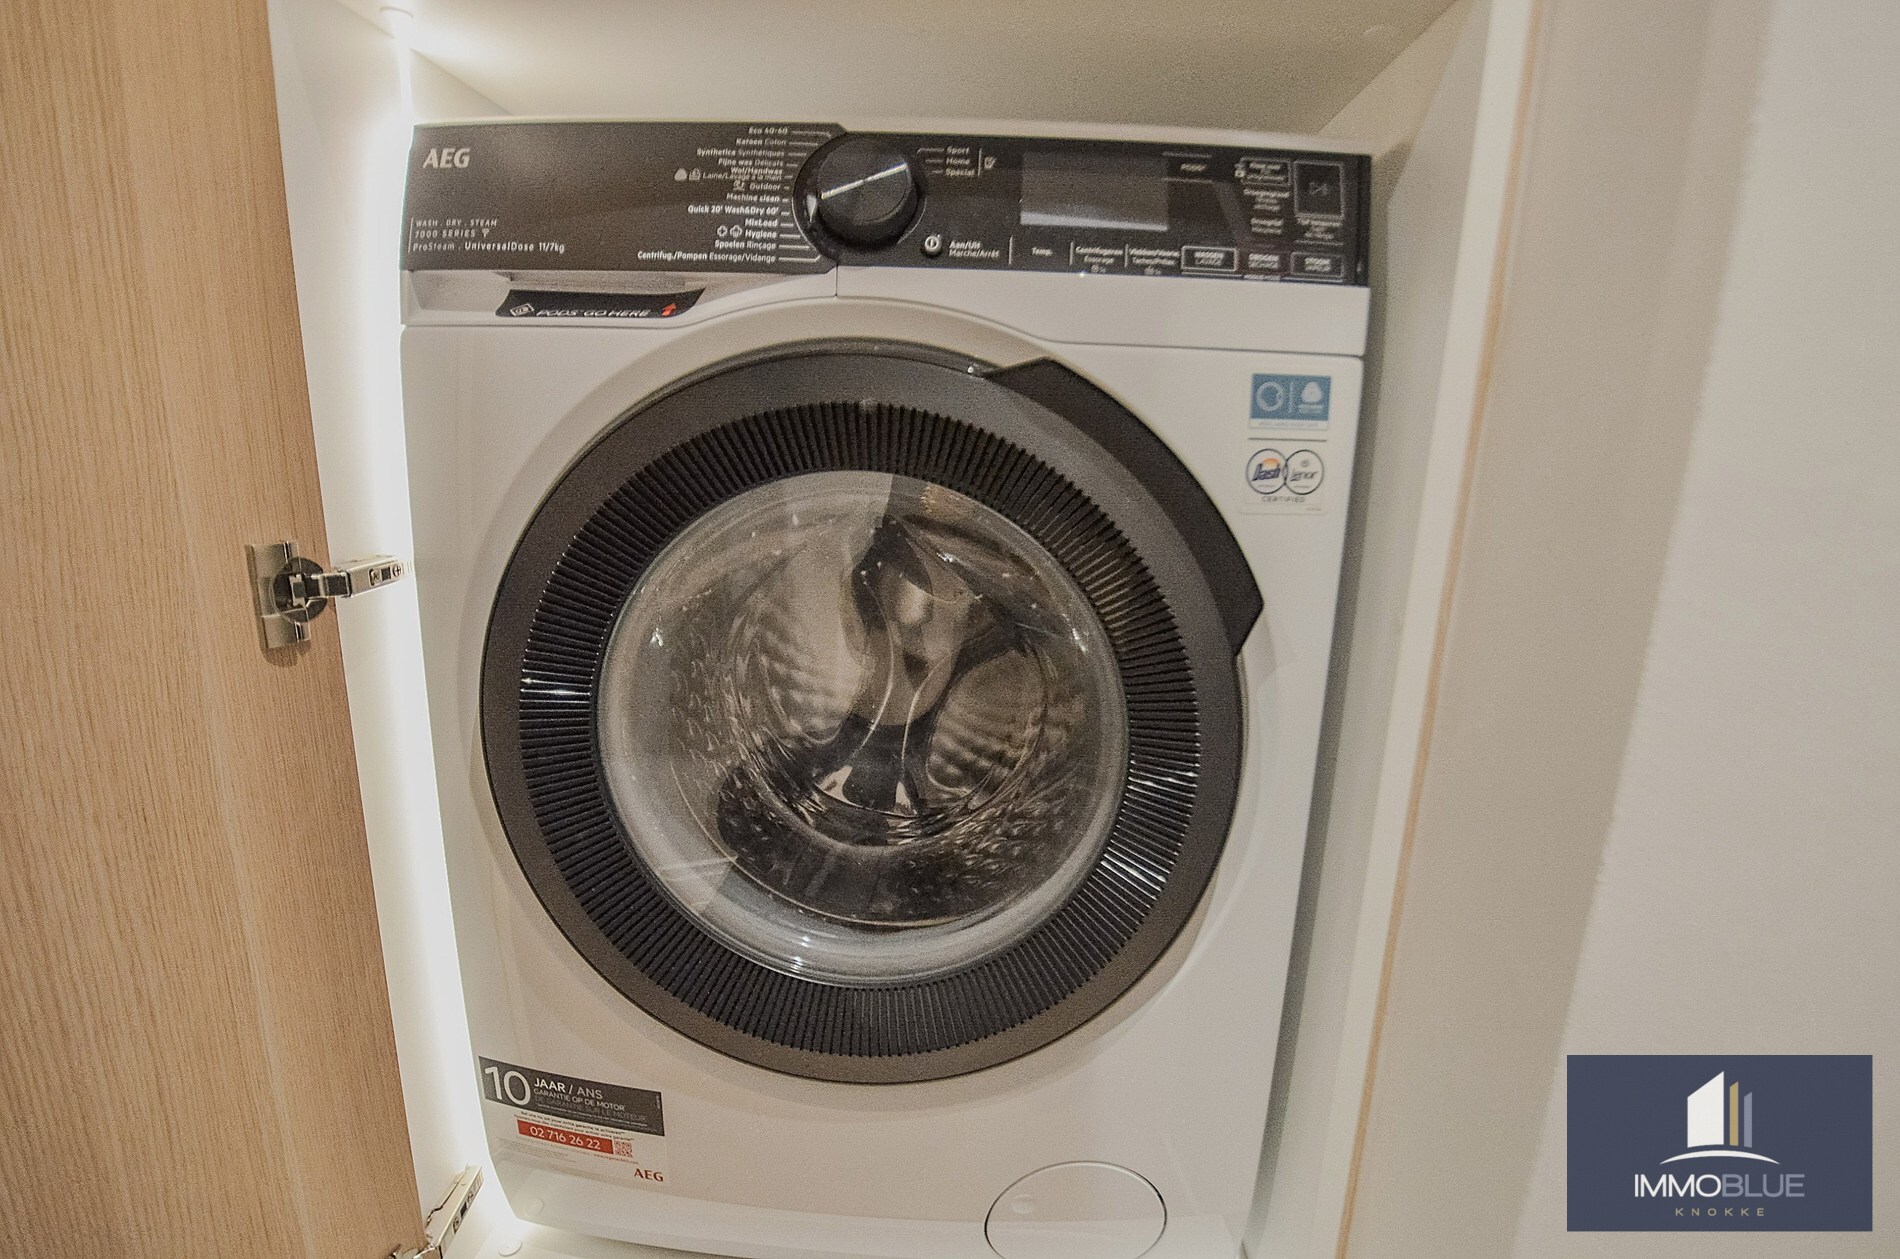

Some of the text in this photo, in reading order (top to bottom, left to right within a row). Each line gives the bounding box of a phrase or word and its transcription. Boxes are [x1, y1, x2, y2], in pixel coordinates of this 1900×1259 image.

[736, 138, 787, 146] Katoen Coton
[946, 146, 970, 154] Sport
[422, 148, 471, 169] AEG
[718, 158, 737, 167] Fijne
[946, 157, 970, 165] Home
[749, 182, 781, 191] Outdoor
[726, 192, 780, 202] Machine clean
[687, 204, 710, 214] Quick
[724, 205, 765, 216] Wash&Dry
[416, 218, 498, 227] WASH DRY STEAM
[744, 218, 778, 228] MixLoad
[414, 229, 476, 238] 7000 SERIES
[413, 242, 566, 254] ProSteam UniversalDose 11/7kg
[714, 240, 777, 251] Spoelen Rinçage
[949, 241, 981, 250] Aan/Uit
[637, 251, 776, 264] Centrifug./Pompen Essorage/Vidange
[584, 309, 607, 317] GO
[607, 310, 650, 318] HERE
[484, 1066, 531, 1106] 10
[534, 1078, 566, 1093] JAAR
[576, 1086, 603, 1100] ANS
[533, 1088, 571, 1102] GARANTIE
[572, 1096, 583, 1104] OP
[584, 1098, 596, 1106] DE
[530, 1126, 544, 1138] 02
[548, 1129, 567, 1143] 716
[569, 1134, 584, 1147] 26
[586, 1138, 602, 1150] 22
[634, 1168, 664, 1182] AEG
